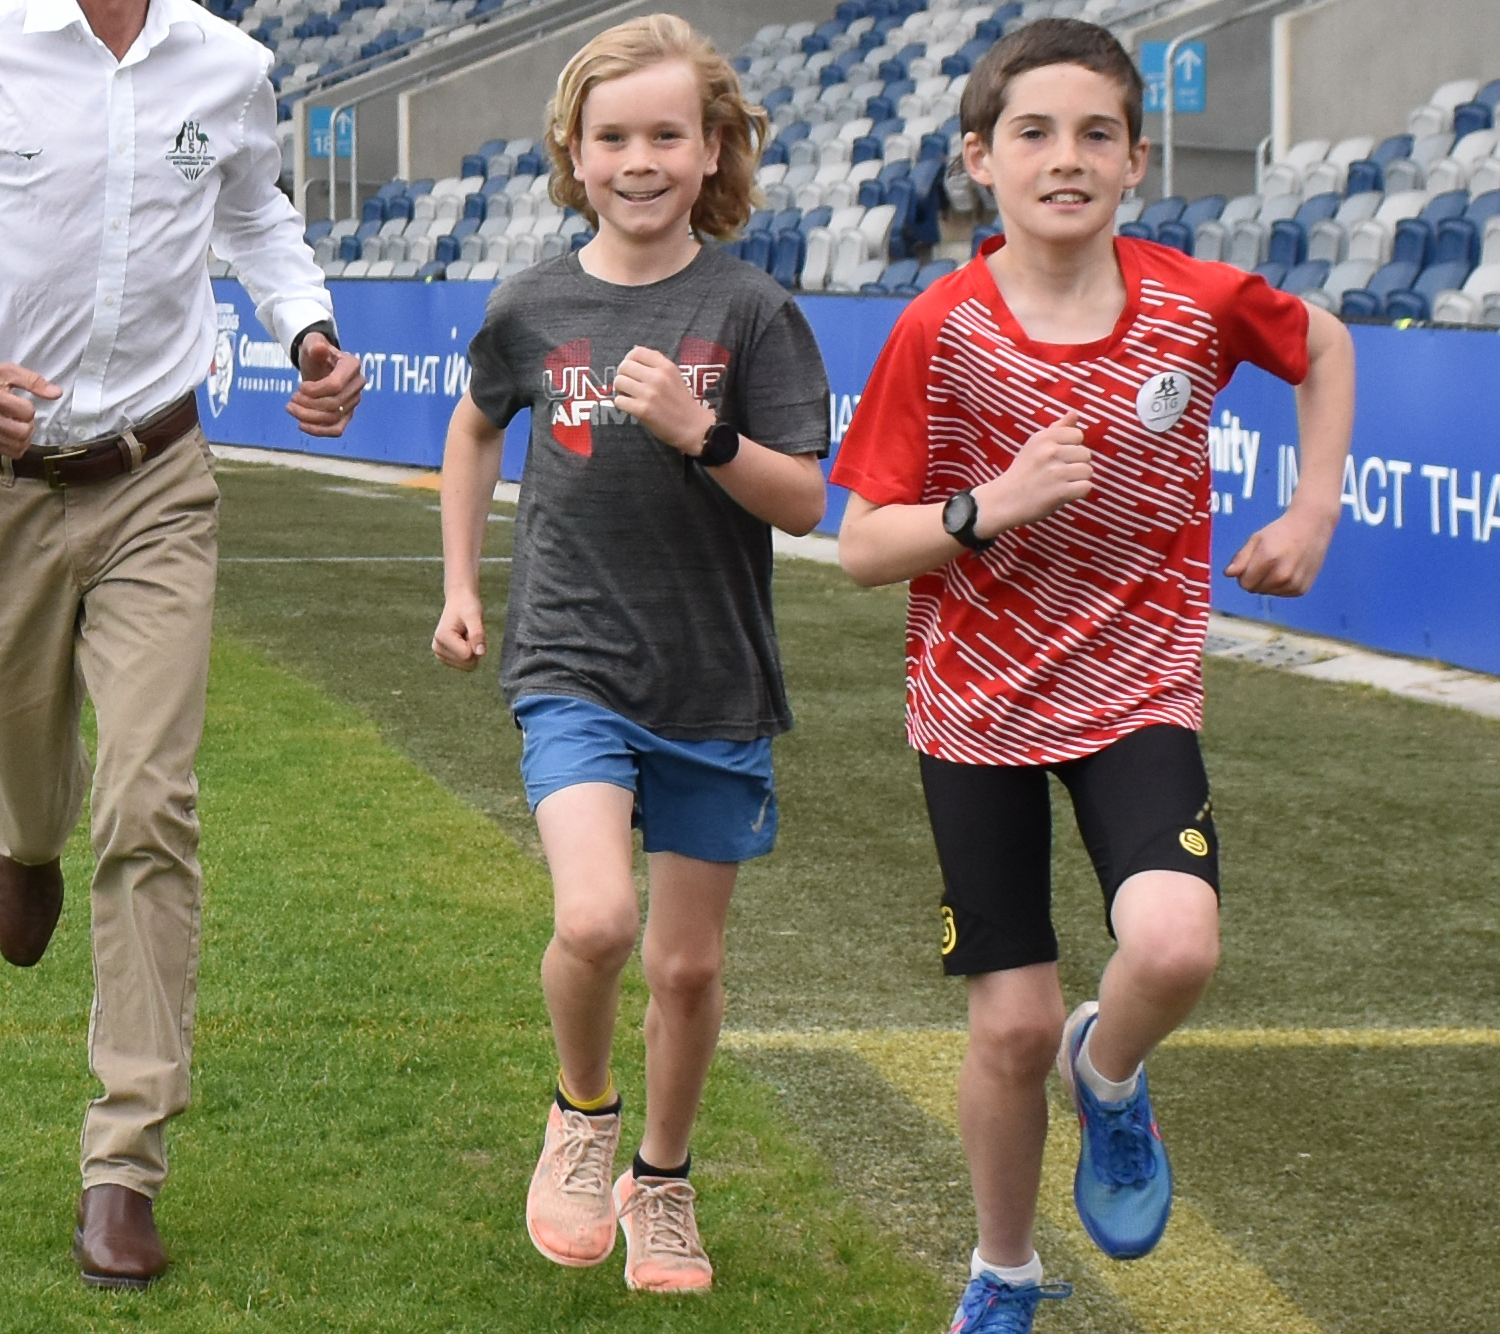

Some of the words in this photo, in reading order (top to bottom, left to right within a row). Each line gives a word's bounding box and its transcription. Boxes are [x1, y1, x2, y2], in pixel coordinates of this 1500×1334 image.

[391, 353, 441, 395] THAT
[238, 376, 293, 393] FOUNDATION
[1151, 397, 1178, 413] OTG
